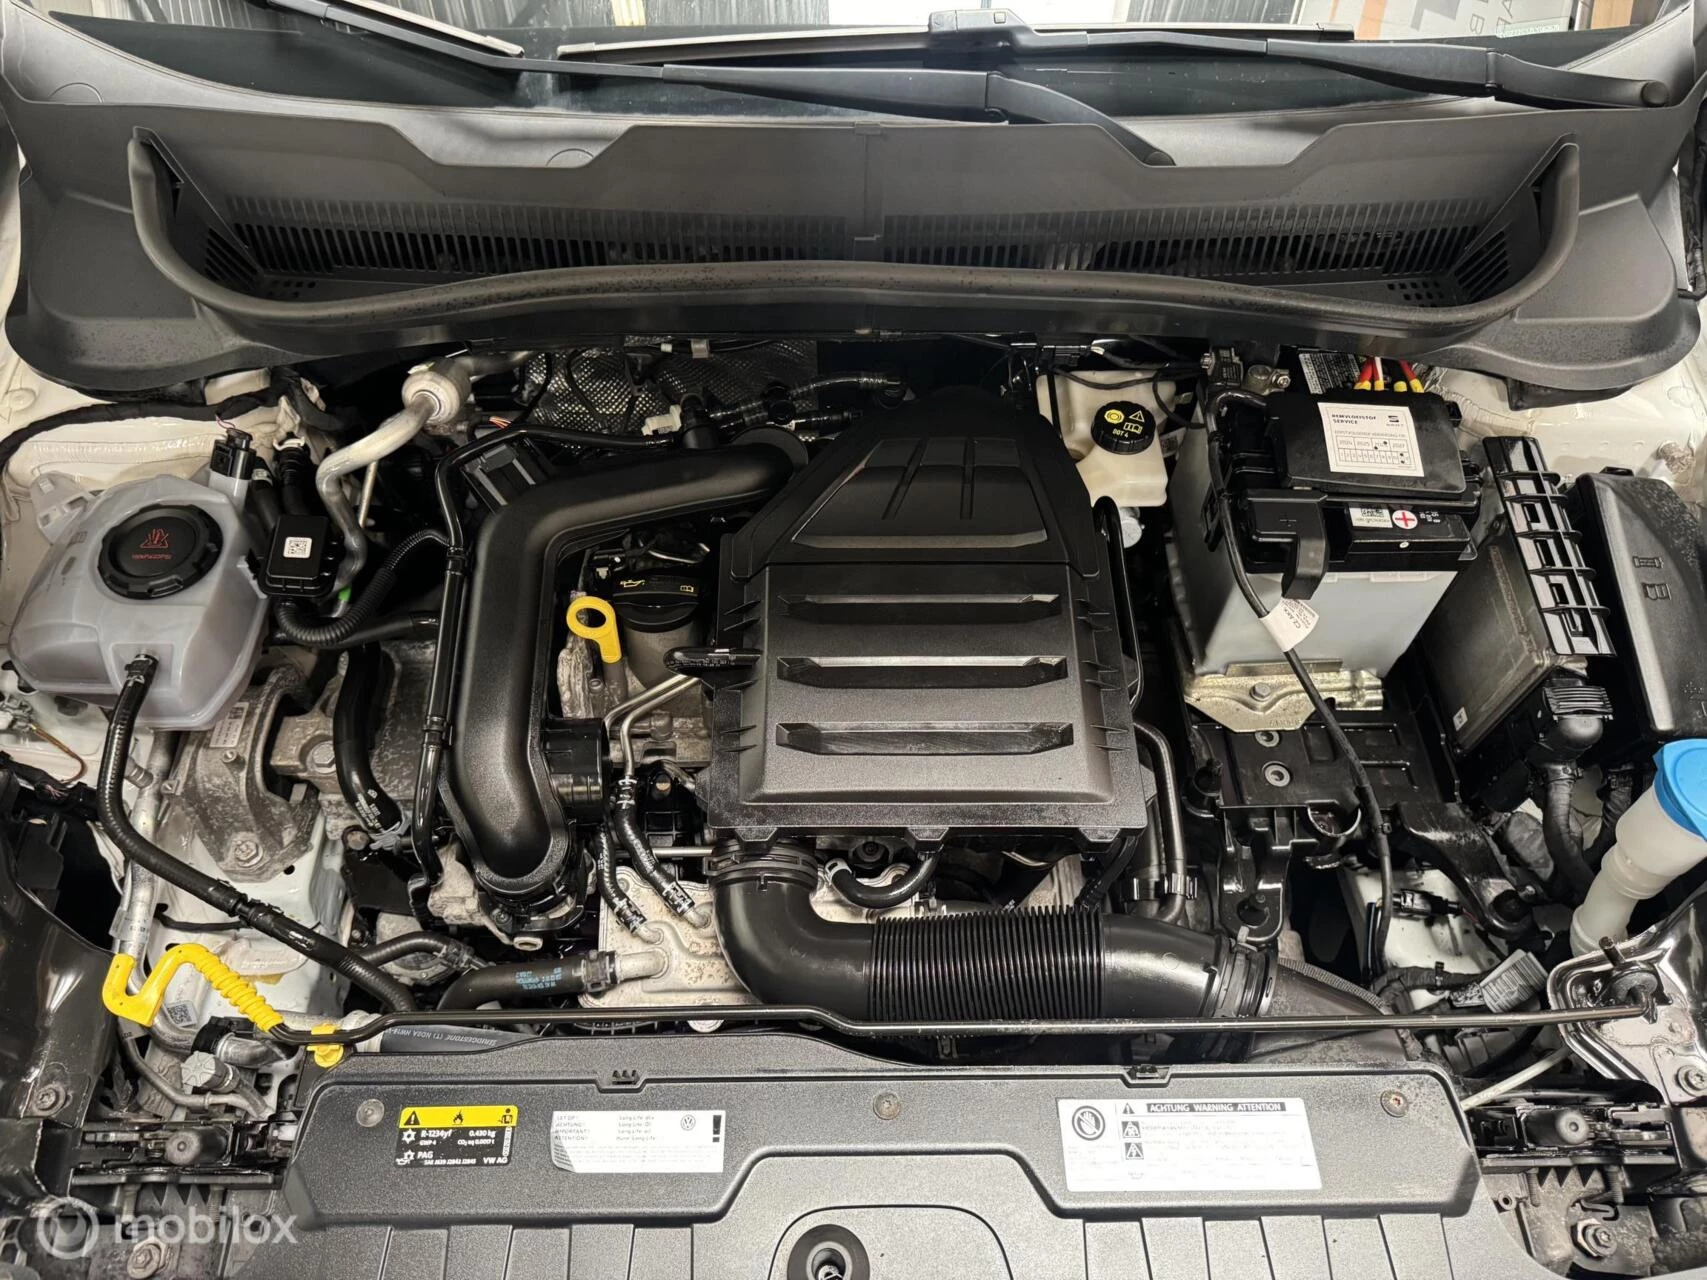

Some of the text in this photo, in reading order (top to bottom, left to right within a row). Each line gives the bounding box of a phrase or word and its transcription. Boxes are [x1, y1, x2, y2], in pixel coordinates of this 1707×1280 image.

[1112, 428, 1124, 436] DOT
[1150, 1103, 1281, 1112] ACHTUNG WARNING ATTENTION
[421, 1129, 452, 1139] R-1234yf
[488, 1130, 496, 1138] kg
[417, 1151, 433, 1159] PAG
